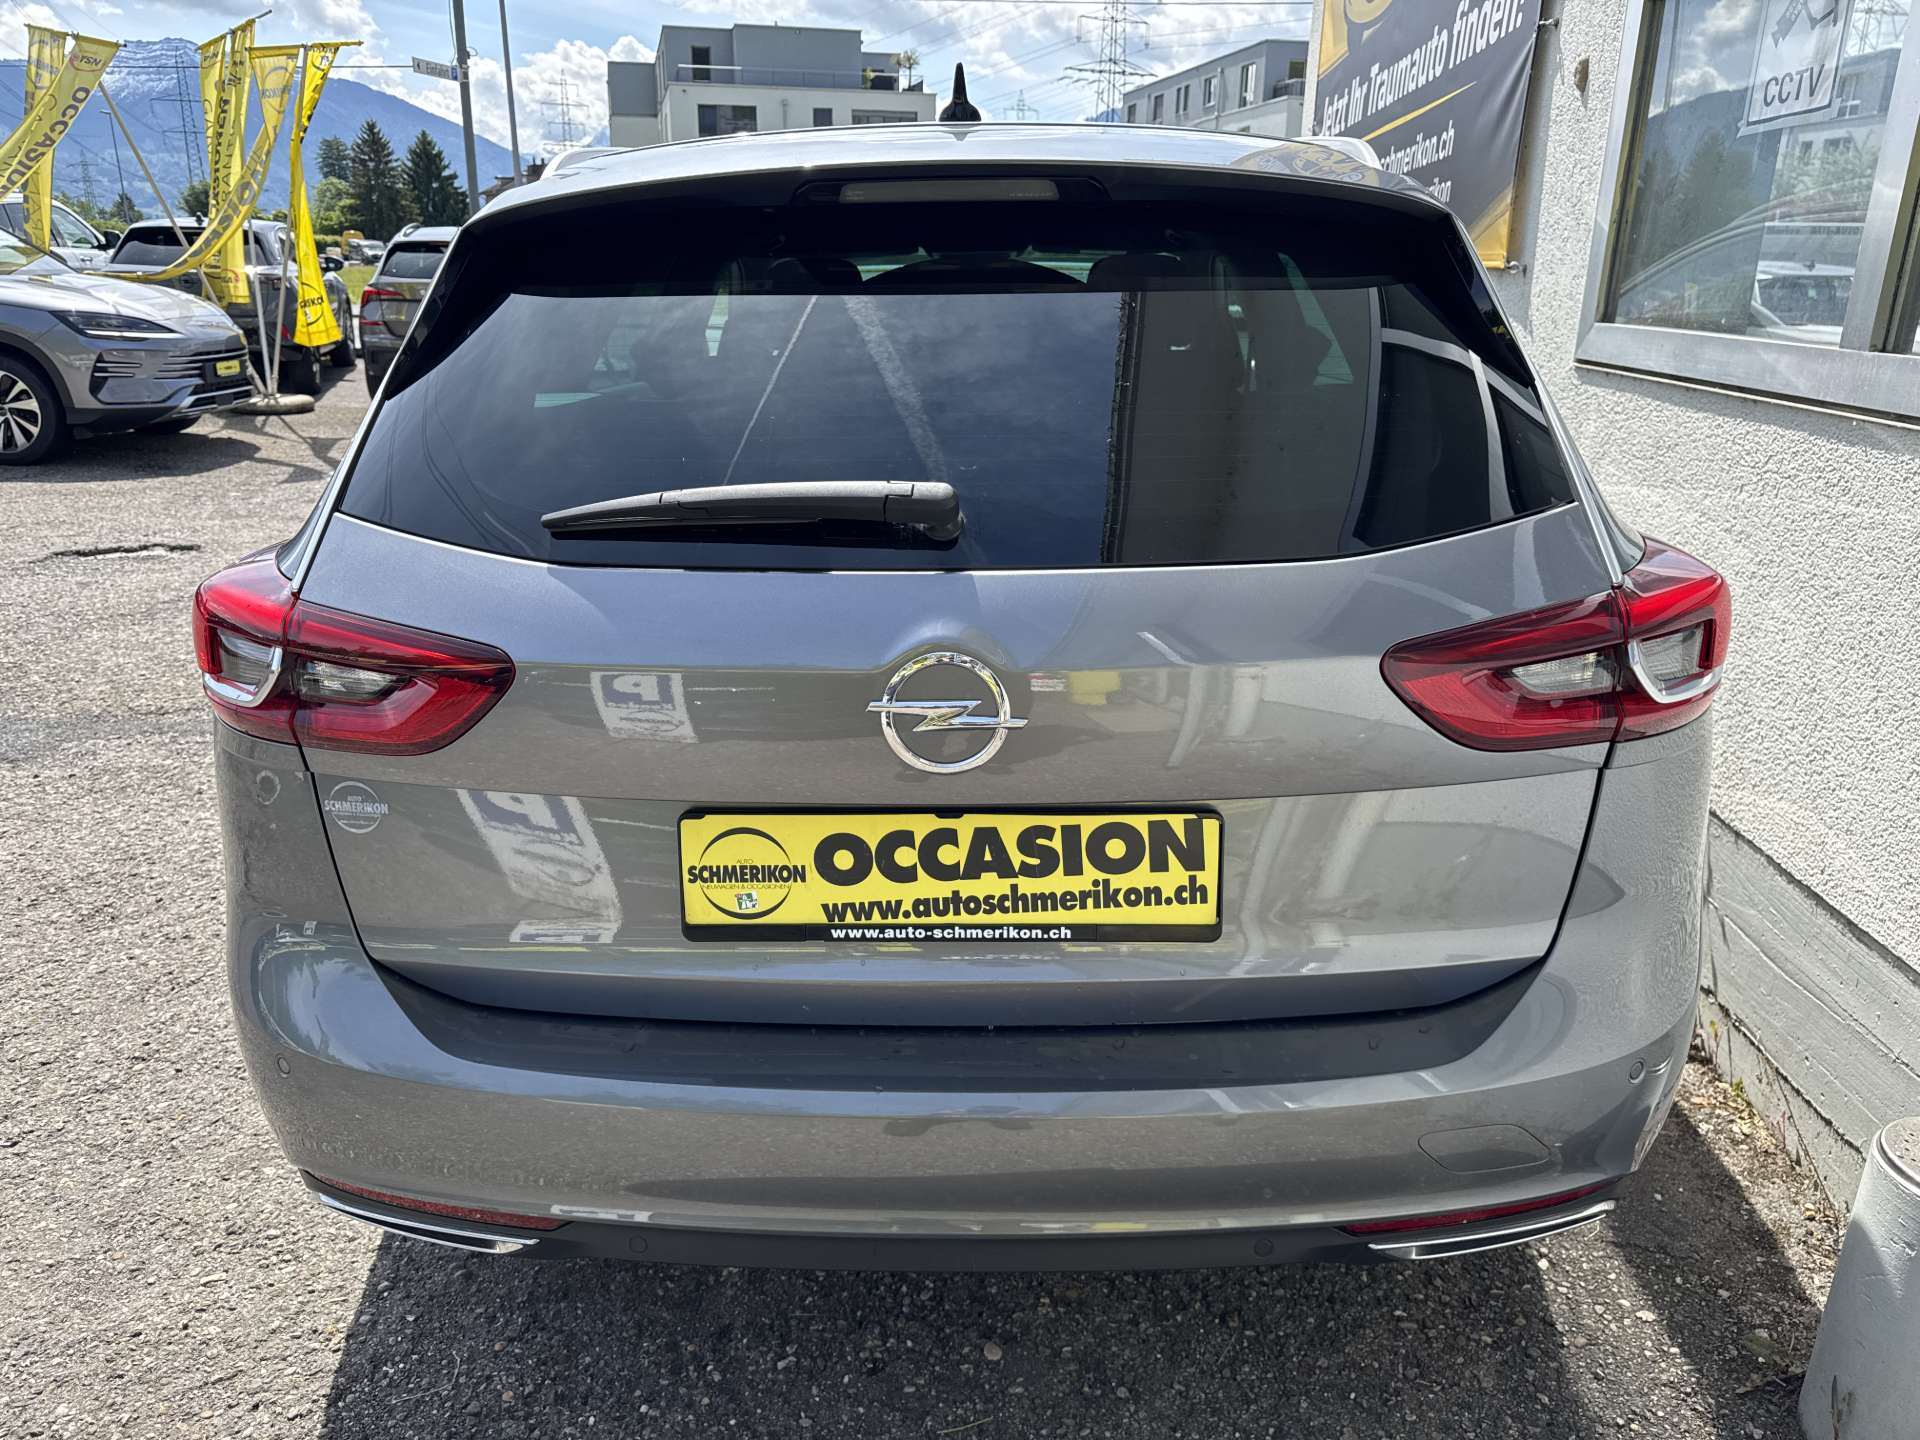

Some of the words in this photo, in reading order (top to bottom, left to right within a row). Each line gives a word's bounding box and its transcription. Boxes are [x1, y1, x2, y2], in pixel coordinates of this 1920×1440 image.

[1320, 89, 1348, 136] Jetzt
[1347, 75, 1368, 127] Ihr
[1367, 25, 1449, 116] Traumauto
[1763, 63, 1825, 107] CCTV
[324, 799, 389, 815] SCHMERIKON
[688, 865, 806, 883] SCHMERIKON
[813, 818, 1206, 887] OCCASION
[820, 874, 1209, 924] www.autoschmerikon.ch
[830, 925, 1073, 941] www.auto-schmerikon.ch
